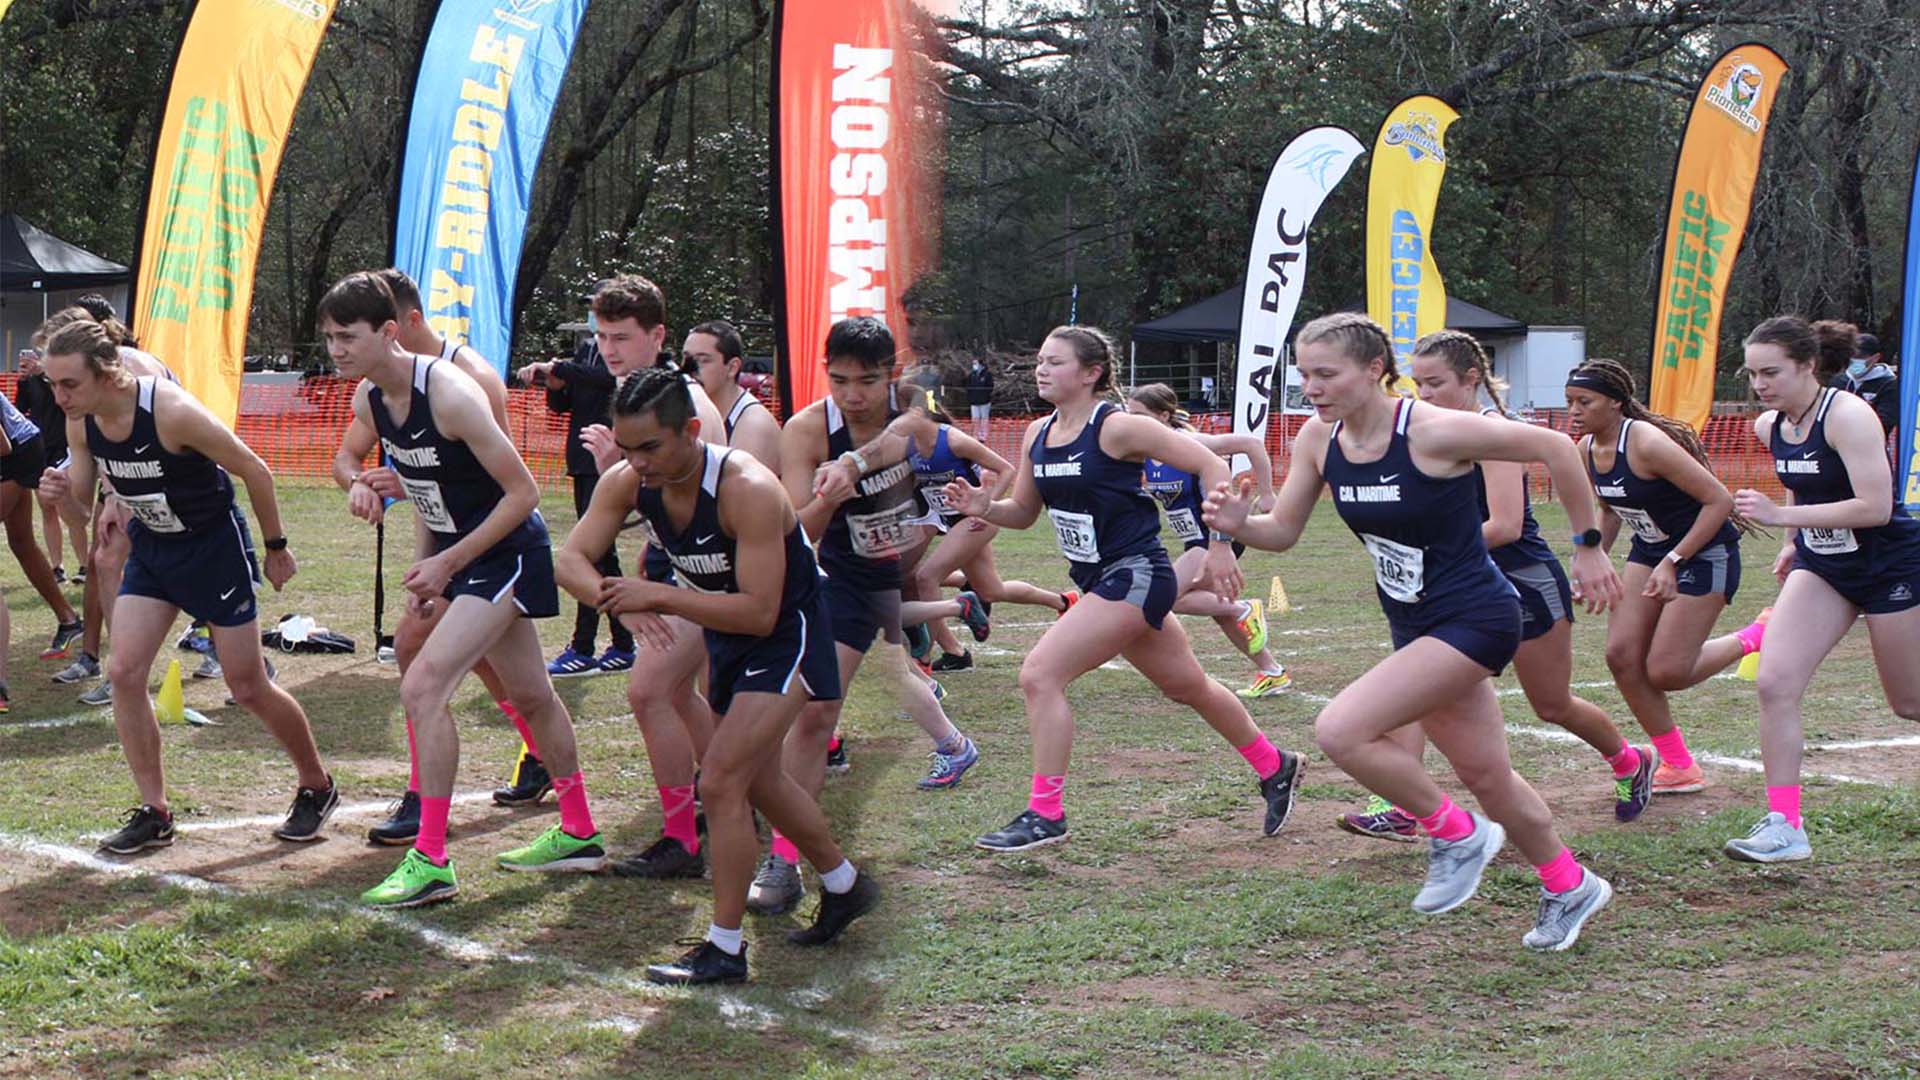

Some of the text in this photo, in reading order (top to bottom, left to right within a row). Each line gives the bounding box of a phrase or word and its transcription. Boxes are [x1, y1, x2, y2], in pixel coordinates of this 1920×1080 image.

[1705, 85, 1761, 132] Pioneers
[150, 96, 227, 324] PACIFIC
[197, 122, 268, 312] UNION
[1260, 207, 1306, 313] PAC
[1663, 190, 1707, 369] PACIFIC
[1683, 213, 1731, 359] UNION
[108, 459, 164, 479] MARITIME
[1033, 462, 1081, 478] CAL MARITIME
[1787, 460, 1820, 474] MARITIME
[1339, 485, 1401, 502] CAL MARITIME
[1059, 527, 1081, 548] 103
[1379, 556, 1405, 583] 102
